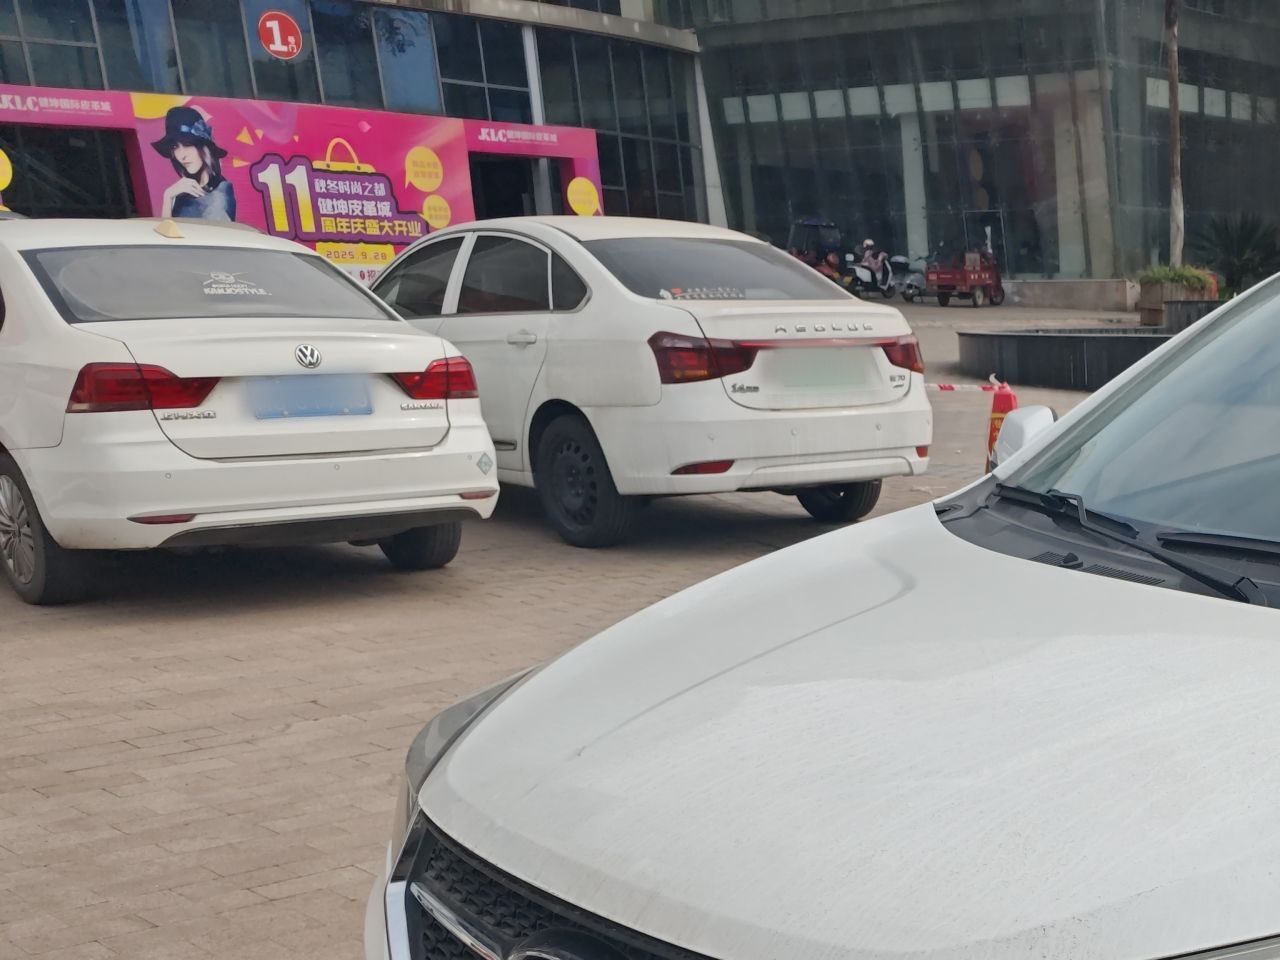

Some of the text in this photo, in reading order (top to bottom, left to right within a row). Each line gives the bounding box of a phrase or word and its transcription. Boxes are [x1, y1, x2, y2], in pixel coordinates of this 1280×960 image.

[258, 163, 316, 232] 11
[314, 178, 386, 197] 秋冬时尚之都
[317, 197, 392, 217] 健坤皮革城
[321, 217, 422, 237] 周年庆盛大开业
